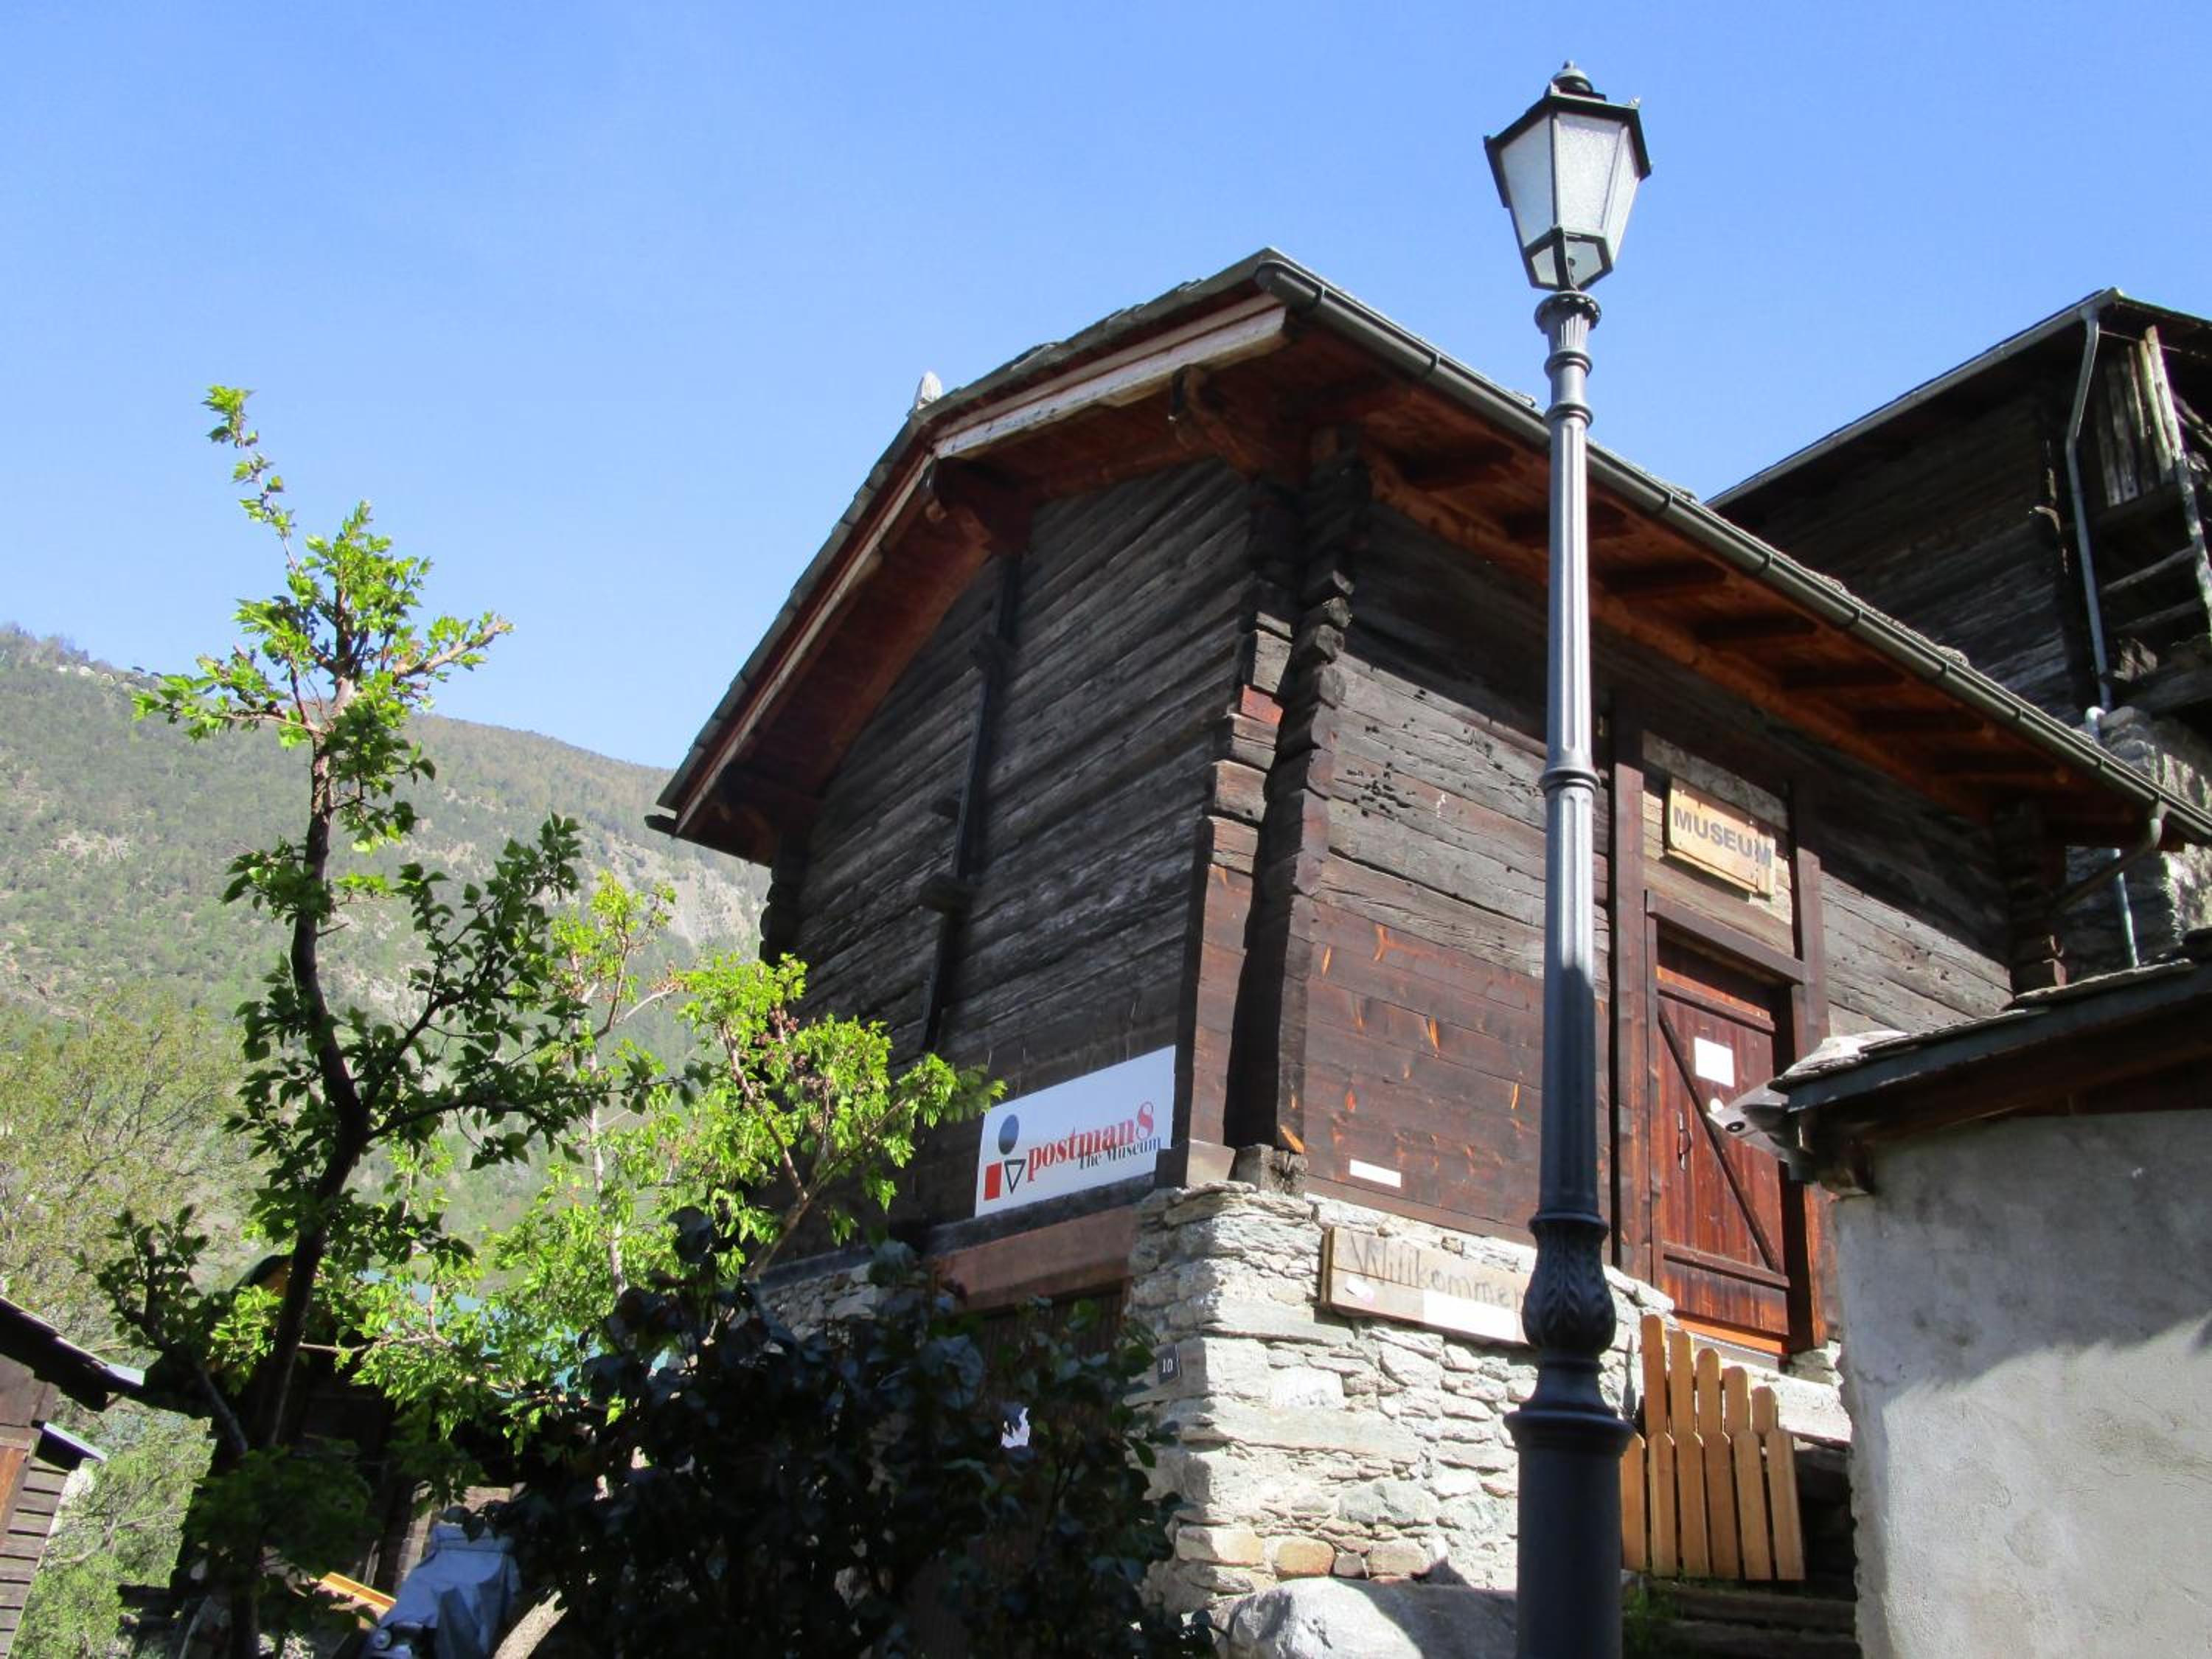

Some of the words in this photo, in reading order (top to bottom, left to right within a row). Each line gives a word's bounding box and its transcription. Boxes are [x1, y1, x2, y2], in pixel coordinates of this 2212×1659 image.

[1674, 806, 1772, 869] MUSEUM
[1077, 1151, 1100, 1169] The
[1107, 1137, 1161, 1161] Museum
[1163, 1357, 1173, 1374] 10
